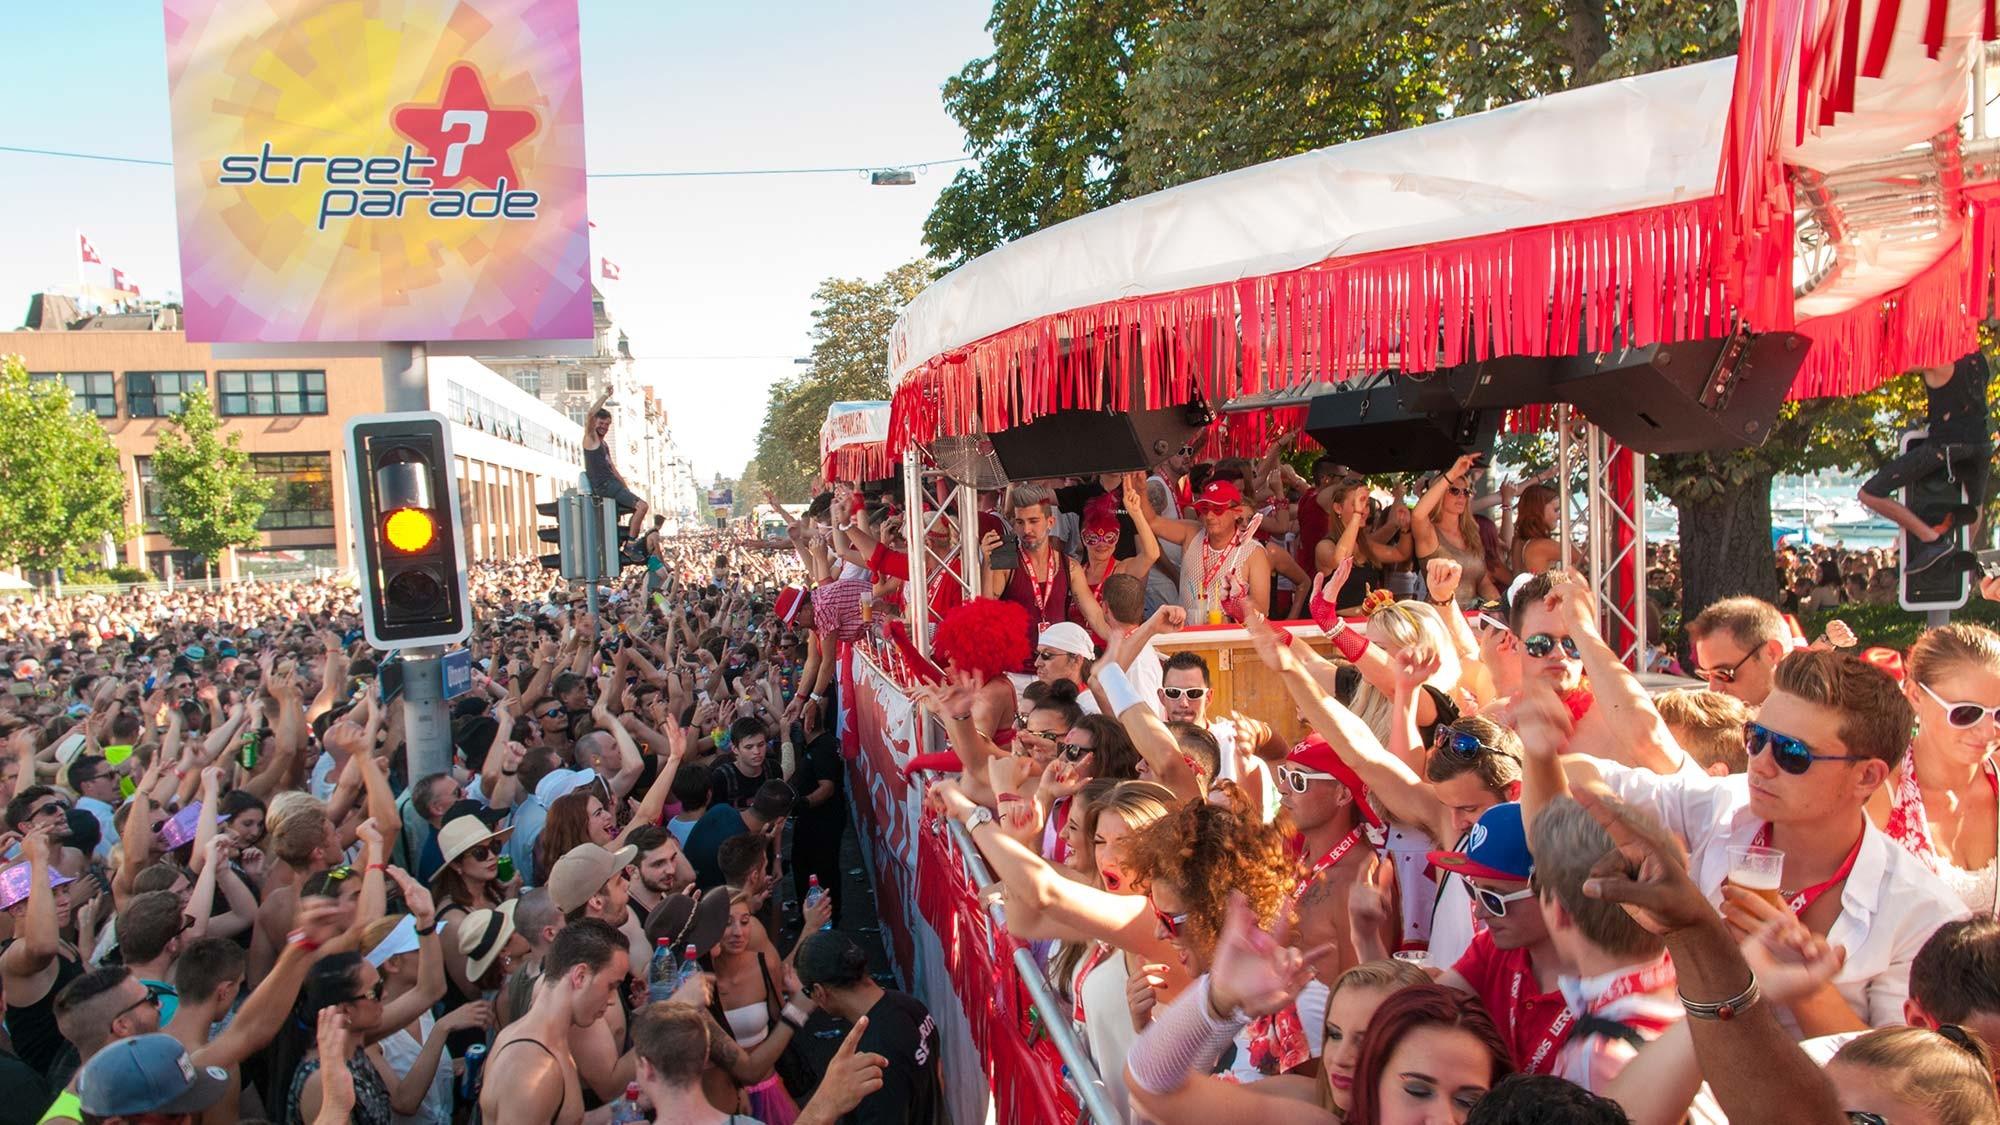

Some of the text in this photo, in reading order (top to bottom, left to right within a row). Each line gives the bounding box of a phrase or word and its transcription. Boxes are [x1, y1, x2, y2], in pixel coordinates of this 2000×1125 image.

[219, 143, 435, 186] street
[318, 177, 539, 229] parade
[1549, 1006, 1574, 1036] LERO
